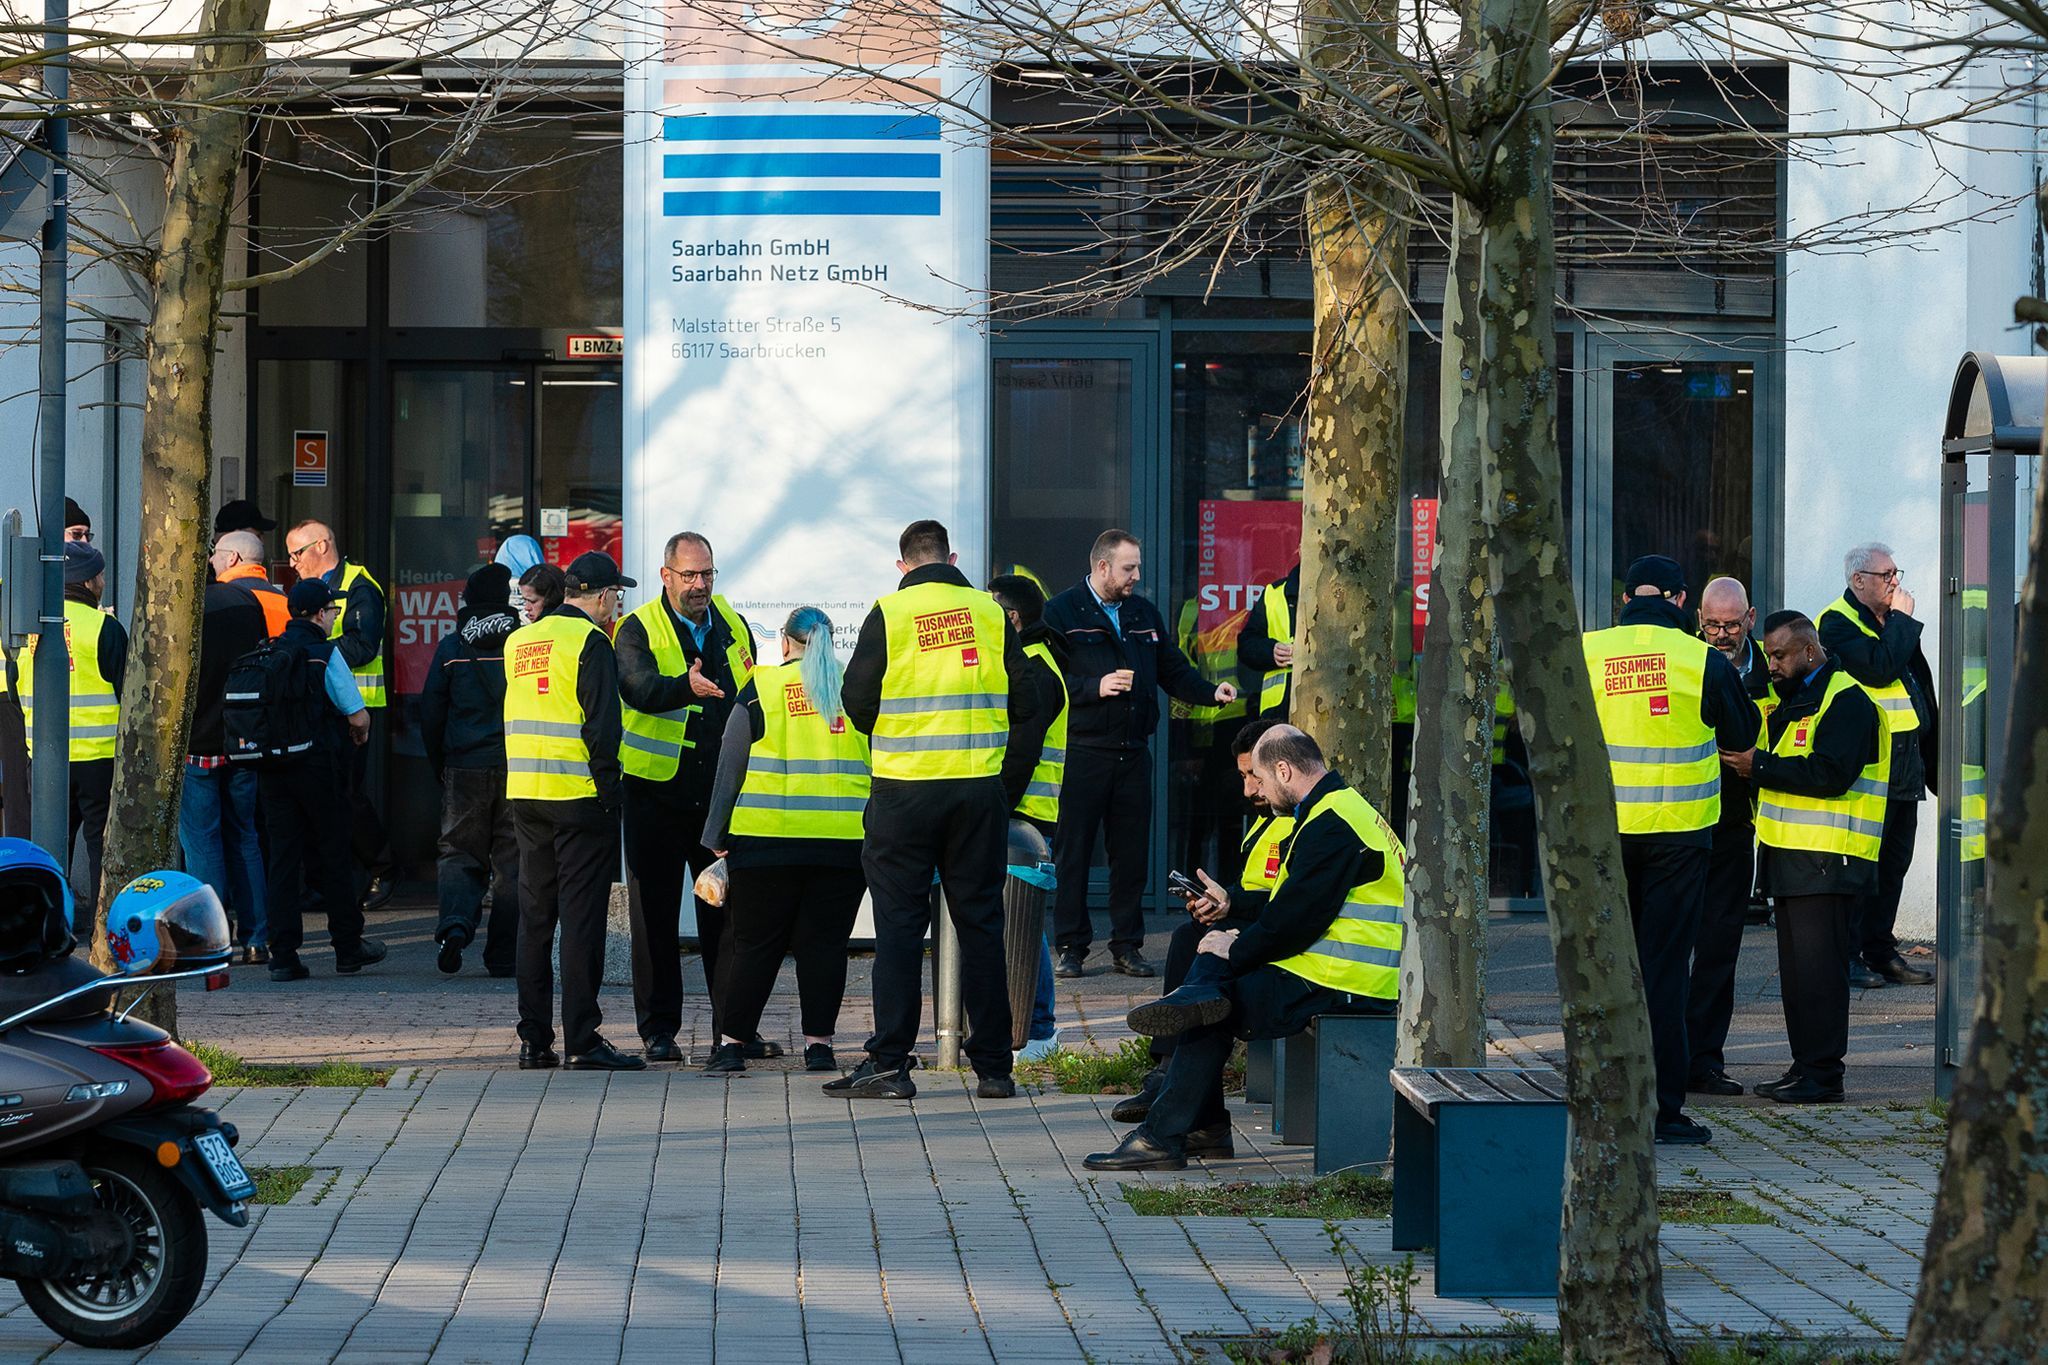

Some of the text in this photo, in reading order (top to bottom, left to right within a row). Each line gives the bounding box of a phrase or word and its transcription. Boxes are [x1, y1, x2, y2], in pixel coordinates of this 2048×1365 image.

[672, 238, 830, 257] Saarbahn GmbH
[672, 264, 888, 282] Saarbahn Netz GmbH
[672, 316, 841, 333] Malstatter Straße 5
[583, 340, 614, 353] BMZ
[671, 342, 826, 359] 66117 Saarbrücken
[303, 441, 318, 466] S
[1199, 503, 1215, 576] Heute:
[1413, 502, 1430, 576] Heute:
[849, 600, 865, 609] mit
[914, 611, 973, 634] ZUSAMMEN
[918, 627, 976, 648] GEHT MEHR
[515, 643, 553, 661] ZUSAMMEN
[514, 657, 550, 673] GEHT MEHR
[1604, 656, 1666, 677] ZUSAMMEN
[1605, 672, 1667, 692] GEHT MEHR
[200, 1136, 229, 1161] 573
[215, 1160, 244, 1185] BOS
